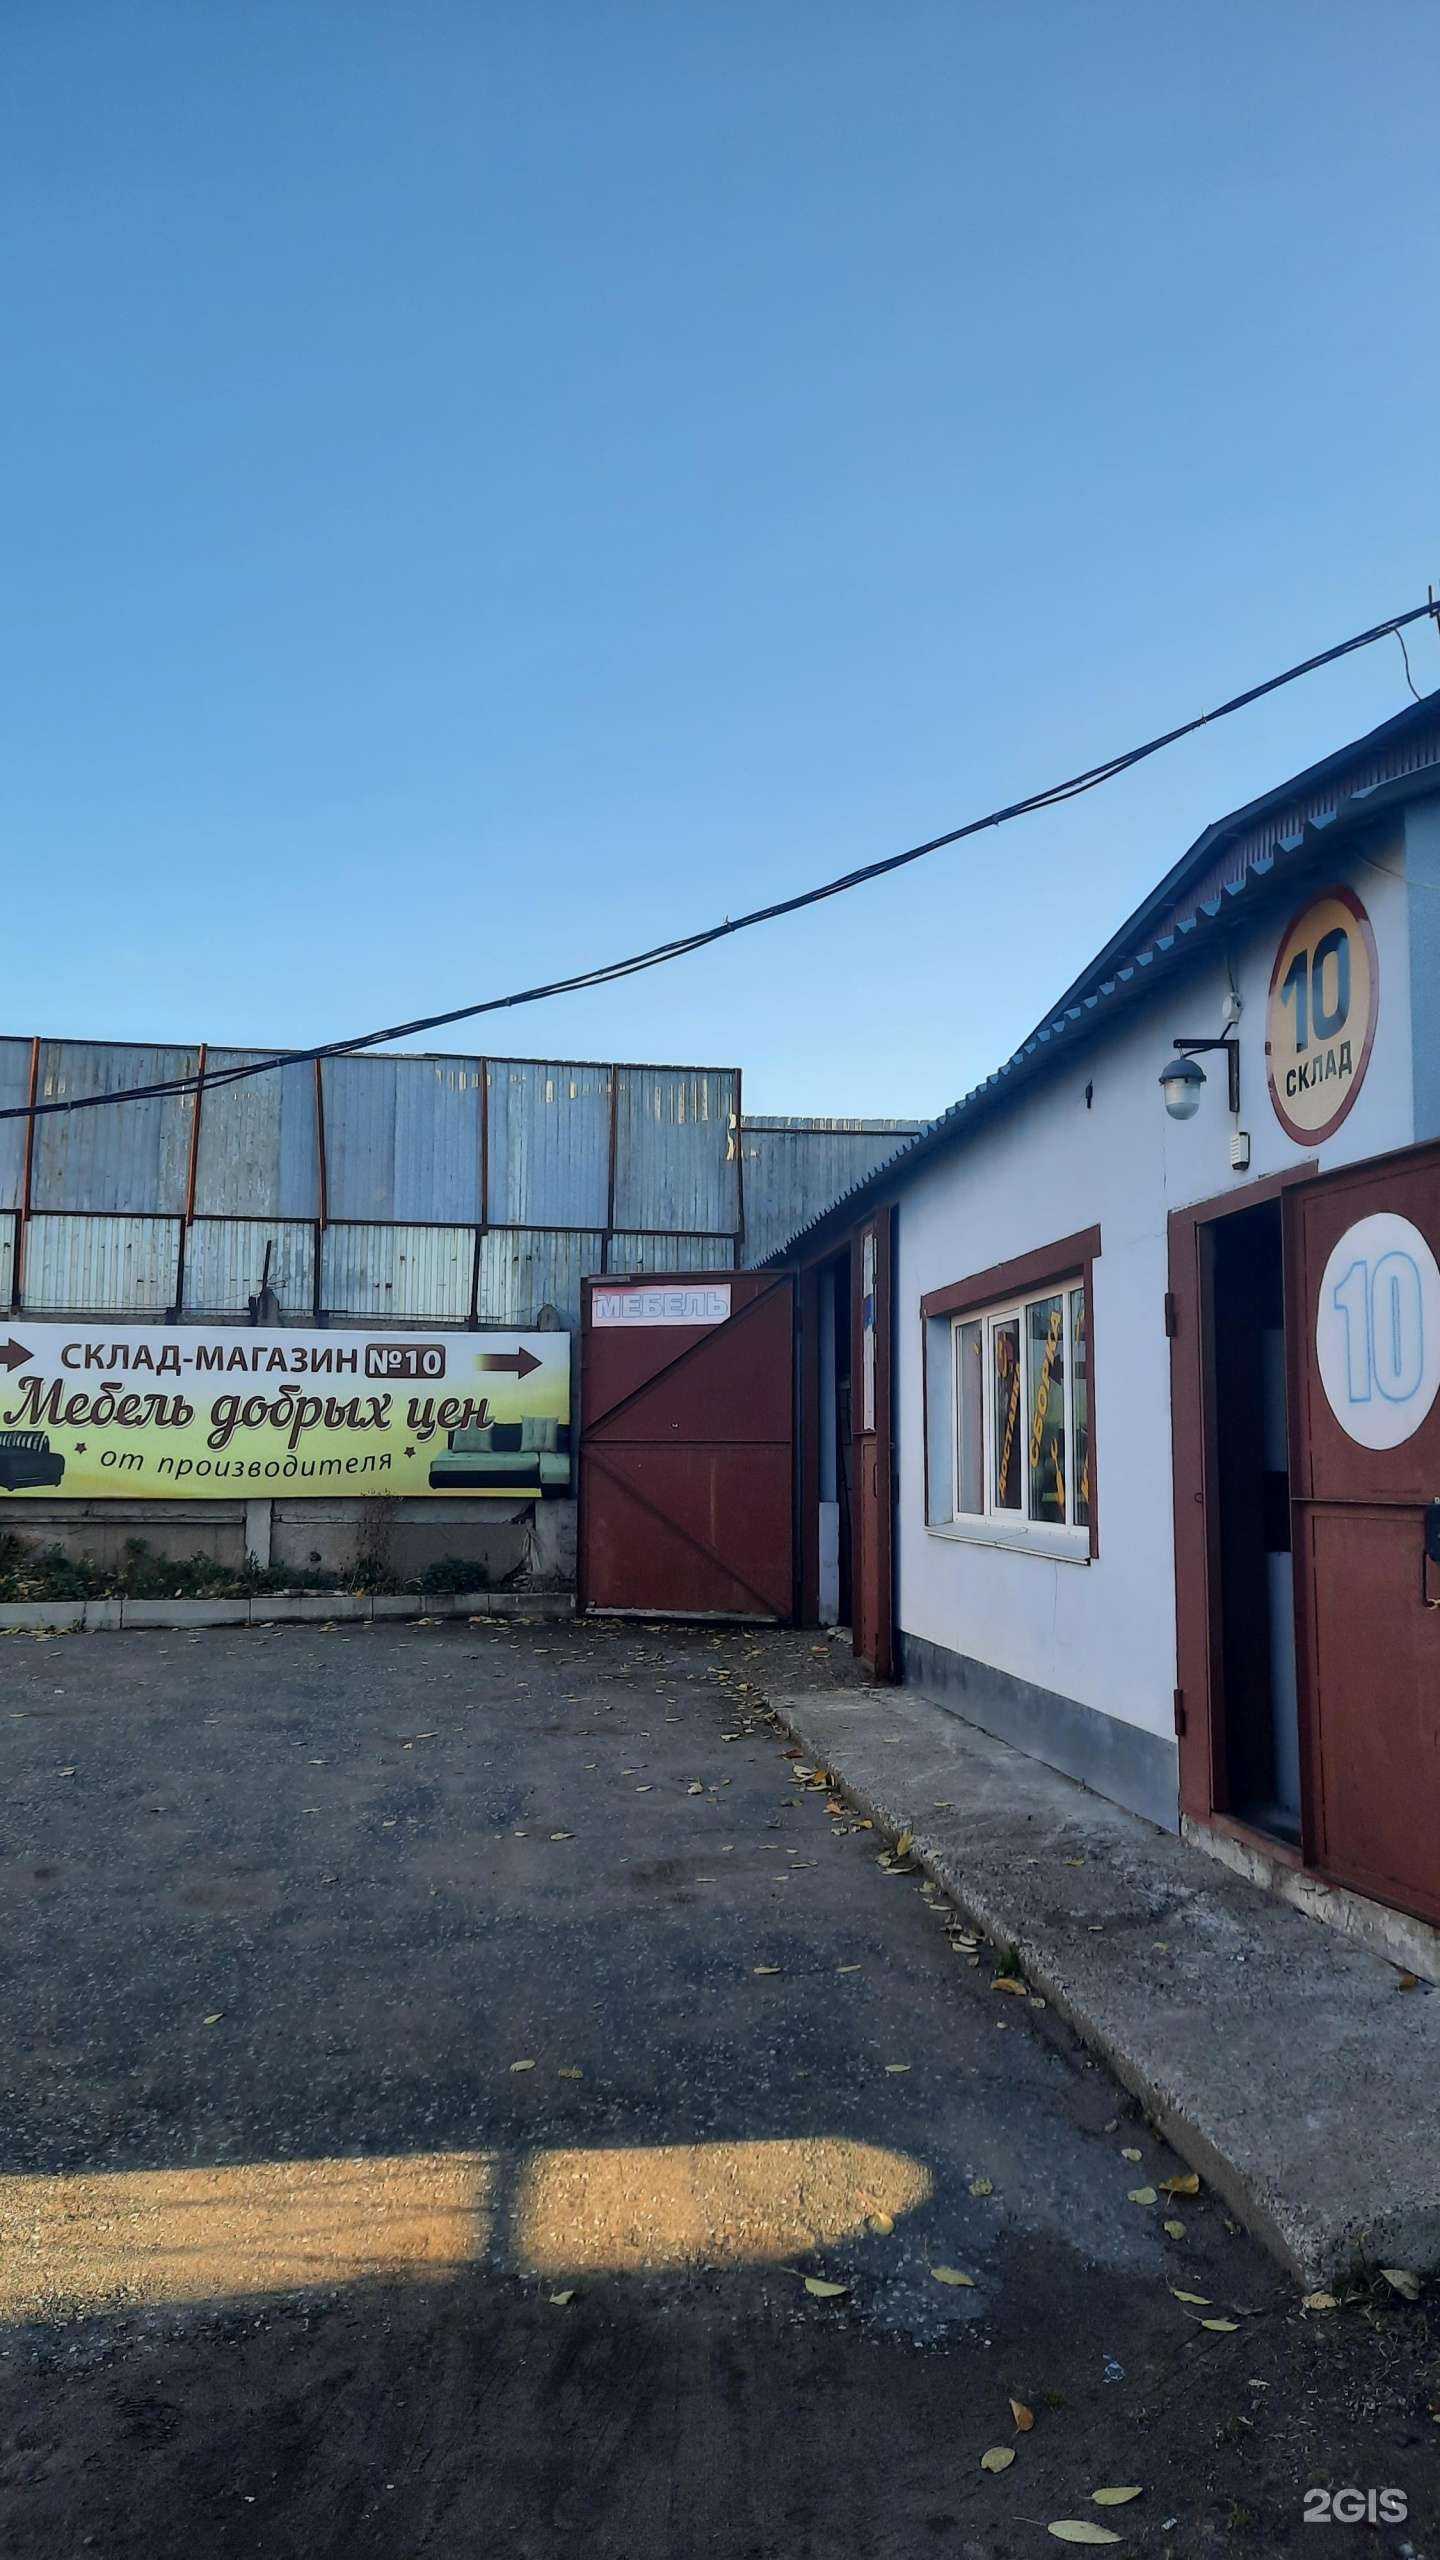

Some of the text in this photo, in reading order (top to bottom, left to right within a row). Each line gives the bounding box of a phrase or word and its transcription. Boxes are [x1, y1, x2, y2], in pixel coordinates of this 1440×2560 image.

[1281, 927, 1349, 1054] 10
[1286, 1040, 1353, 1098] СКЛАД
[596, 1291, 729, 1319] МЕБЕЛЬ
[1334, 1250, 1423, 1403] 10
[60, 1343, 443, 1376] СКЛАД-МАГАЗИН №10
[1030, 1311, 1061, 1468] СБОРКА
[3, 1375, 493, 1451] Мебель добрых цен
[100, 1450, 392, 1478] от производителя
